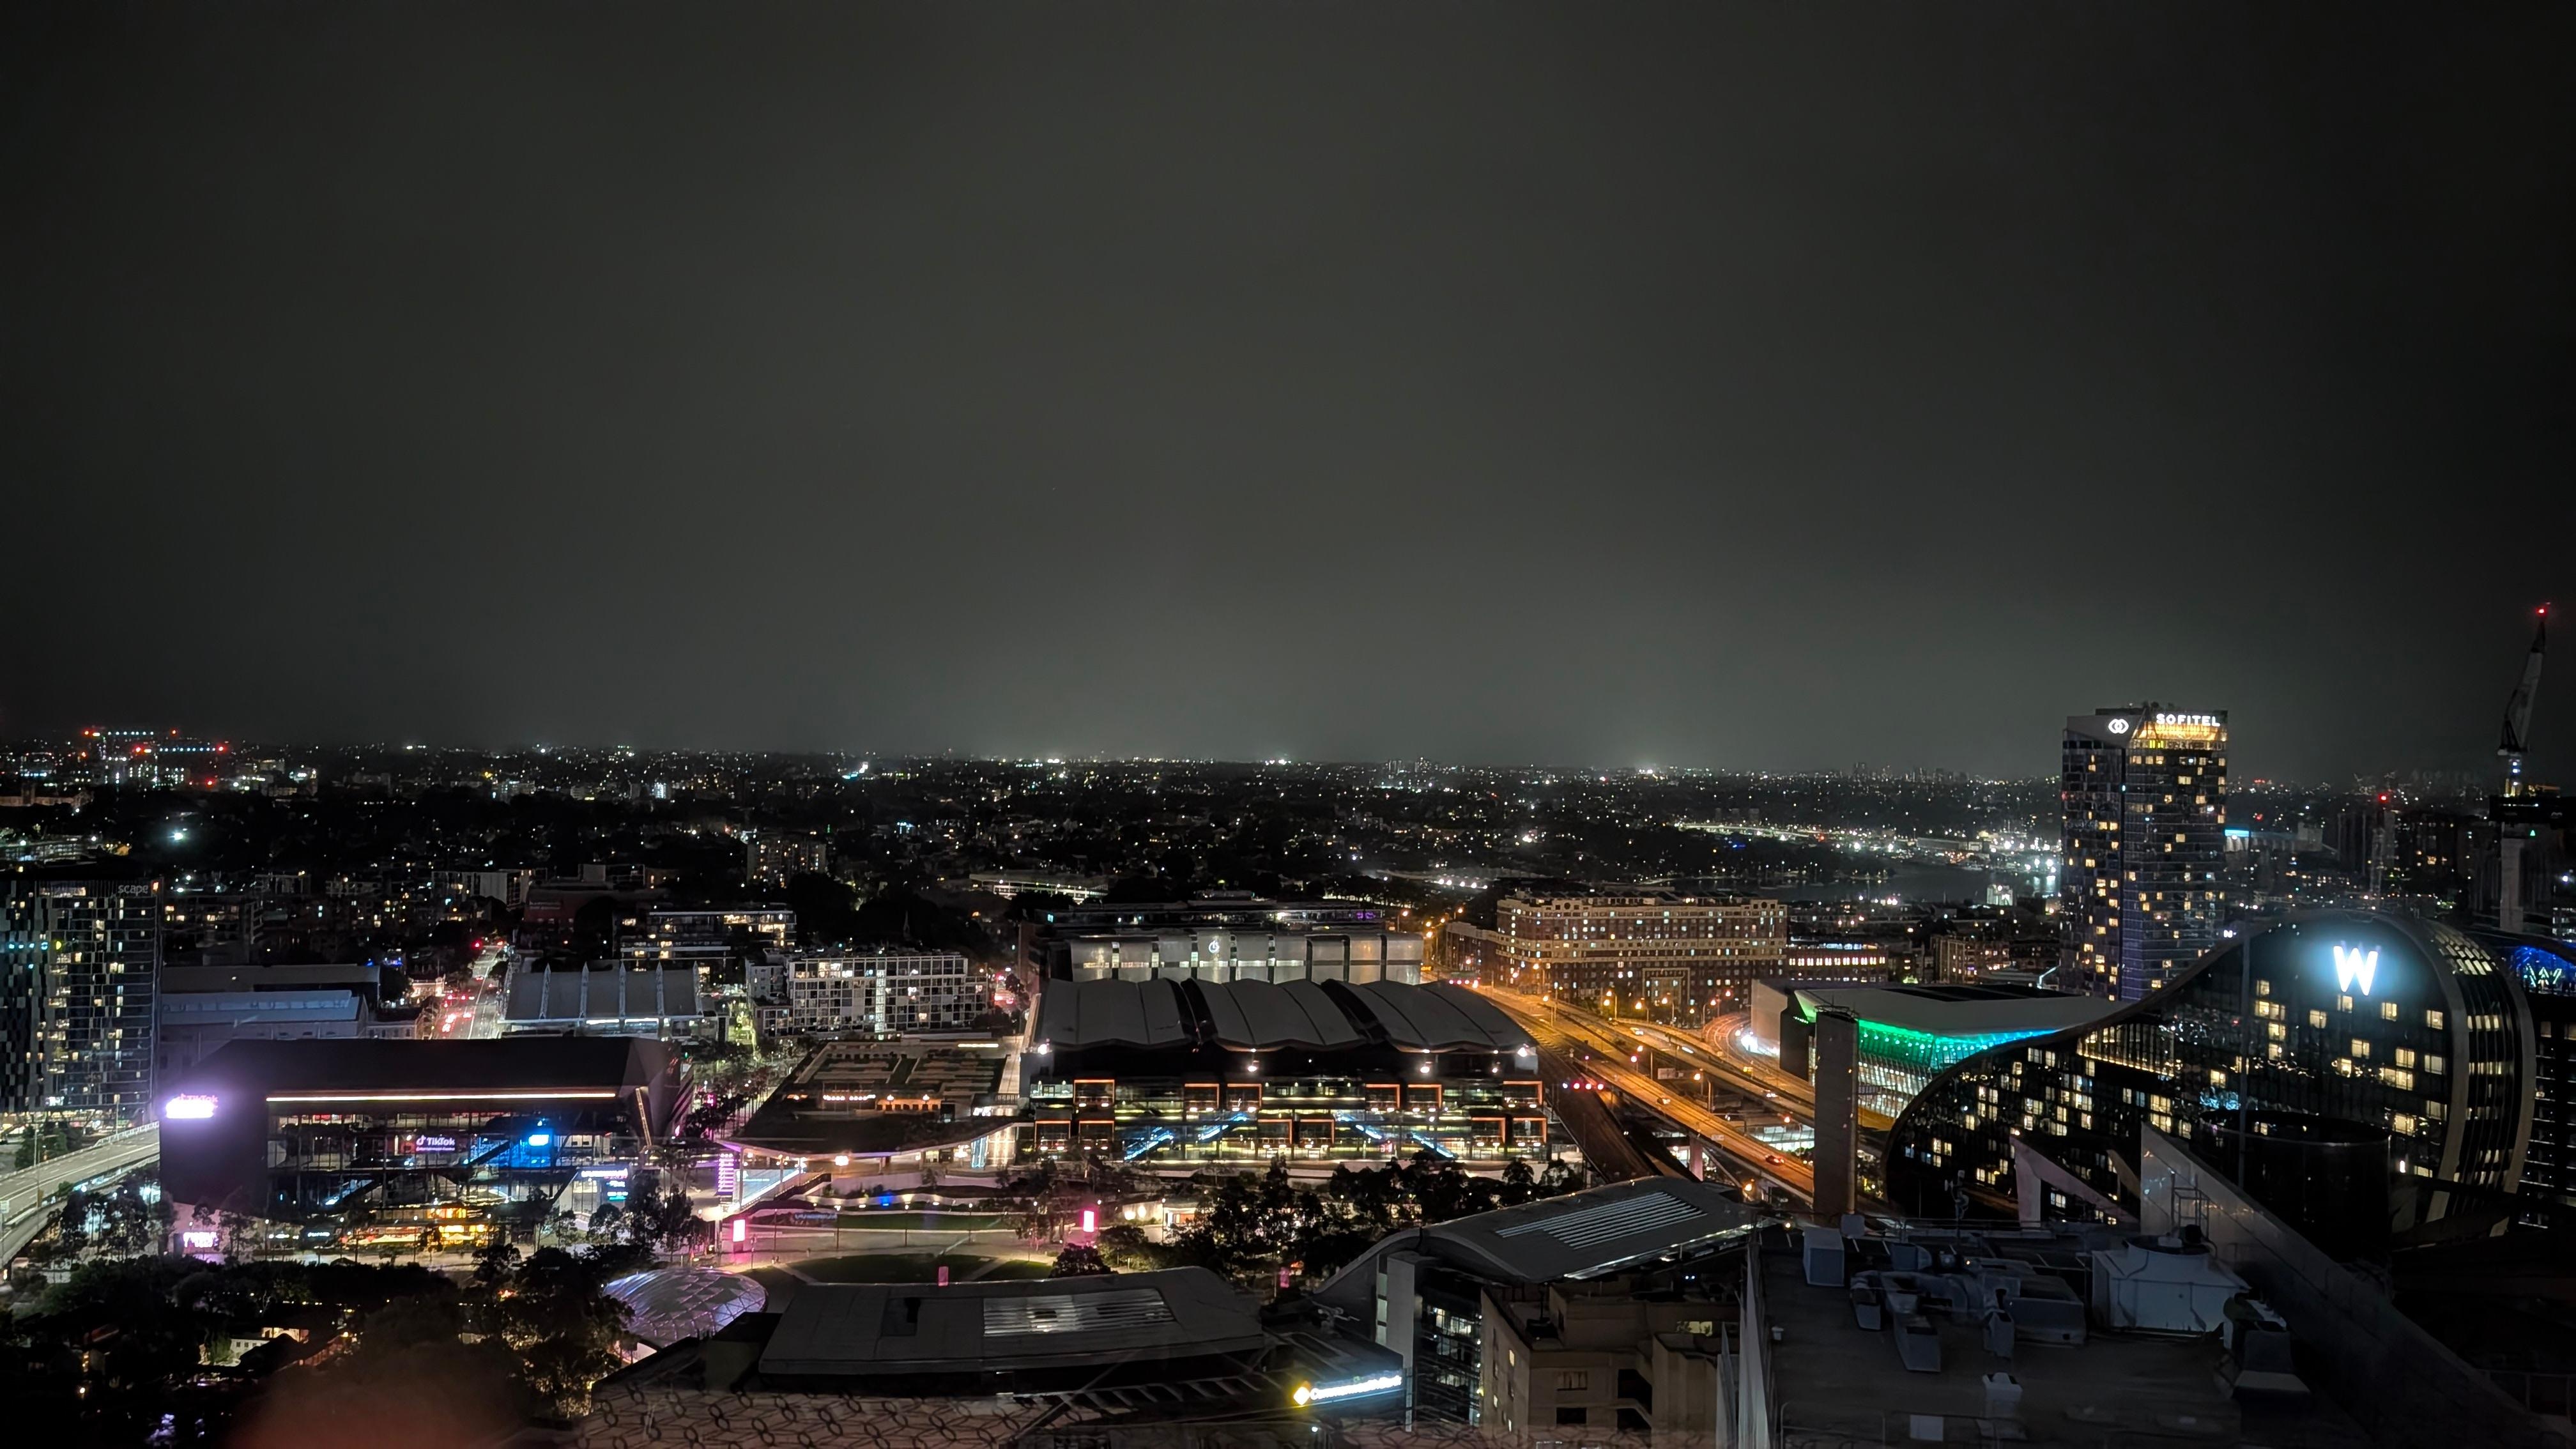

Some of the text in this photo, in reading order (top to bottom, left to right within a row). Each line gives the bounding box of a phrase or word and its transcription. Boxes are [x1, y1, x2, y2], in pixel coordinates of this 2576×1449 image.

[2156, 713, 2220, 727] SOFITEL
[118, 885, 148, 896] scape
[2333, 946, 2378, 996] W
[426, 1137, 456, 1146] TikTok
